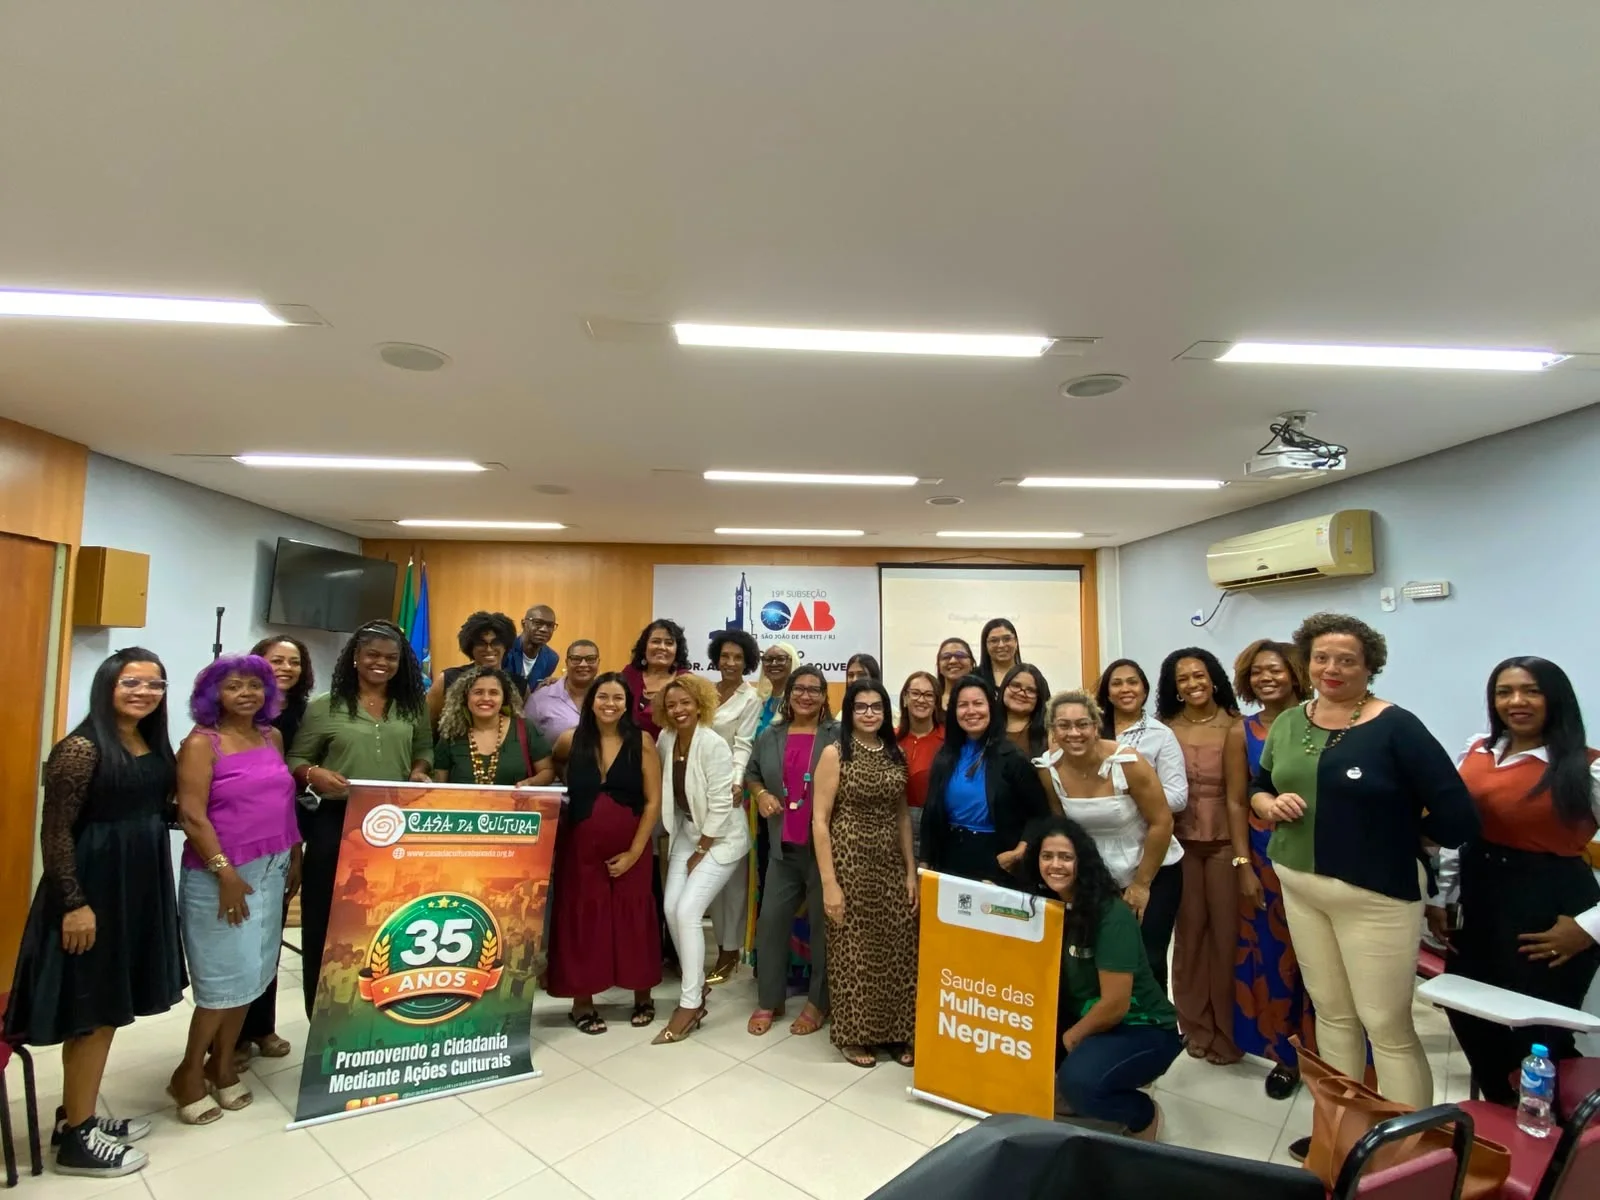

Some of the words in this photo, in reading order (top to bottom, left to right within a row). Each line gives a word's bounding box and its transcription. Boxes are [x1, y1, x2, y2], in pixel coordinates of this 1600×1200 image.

[786, 589, 827, 599] SUBSEÇÃO
[760, 600, 836, 632] OAB
[408, 812, 453, 833] CASA
[456, 821, 473, 832] DA
[477, 813, 538, 834] CULTURA
[400, 918, 473, 966] 35
[397, 970, 467, 993] ANOS
[1001, 984, 1034, 1007] das
[940, 989, 1033, 1031] Mulheres
[335, 1042, 428, 1070] Promovendo
[431, 1043, 440, 1058] a
[443, 1032, 508, 1056] Cidadania
[938, 1011, 1032, 1060] Negras
[328, 1068, 400, 1094] Mediante
[403, 1060, 447, 1086] Ações
[450, 1053, 512, 1076] Culturais
